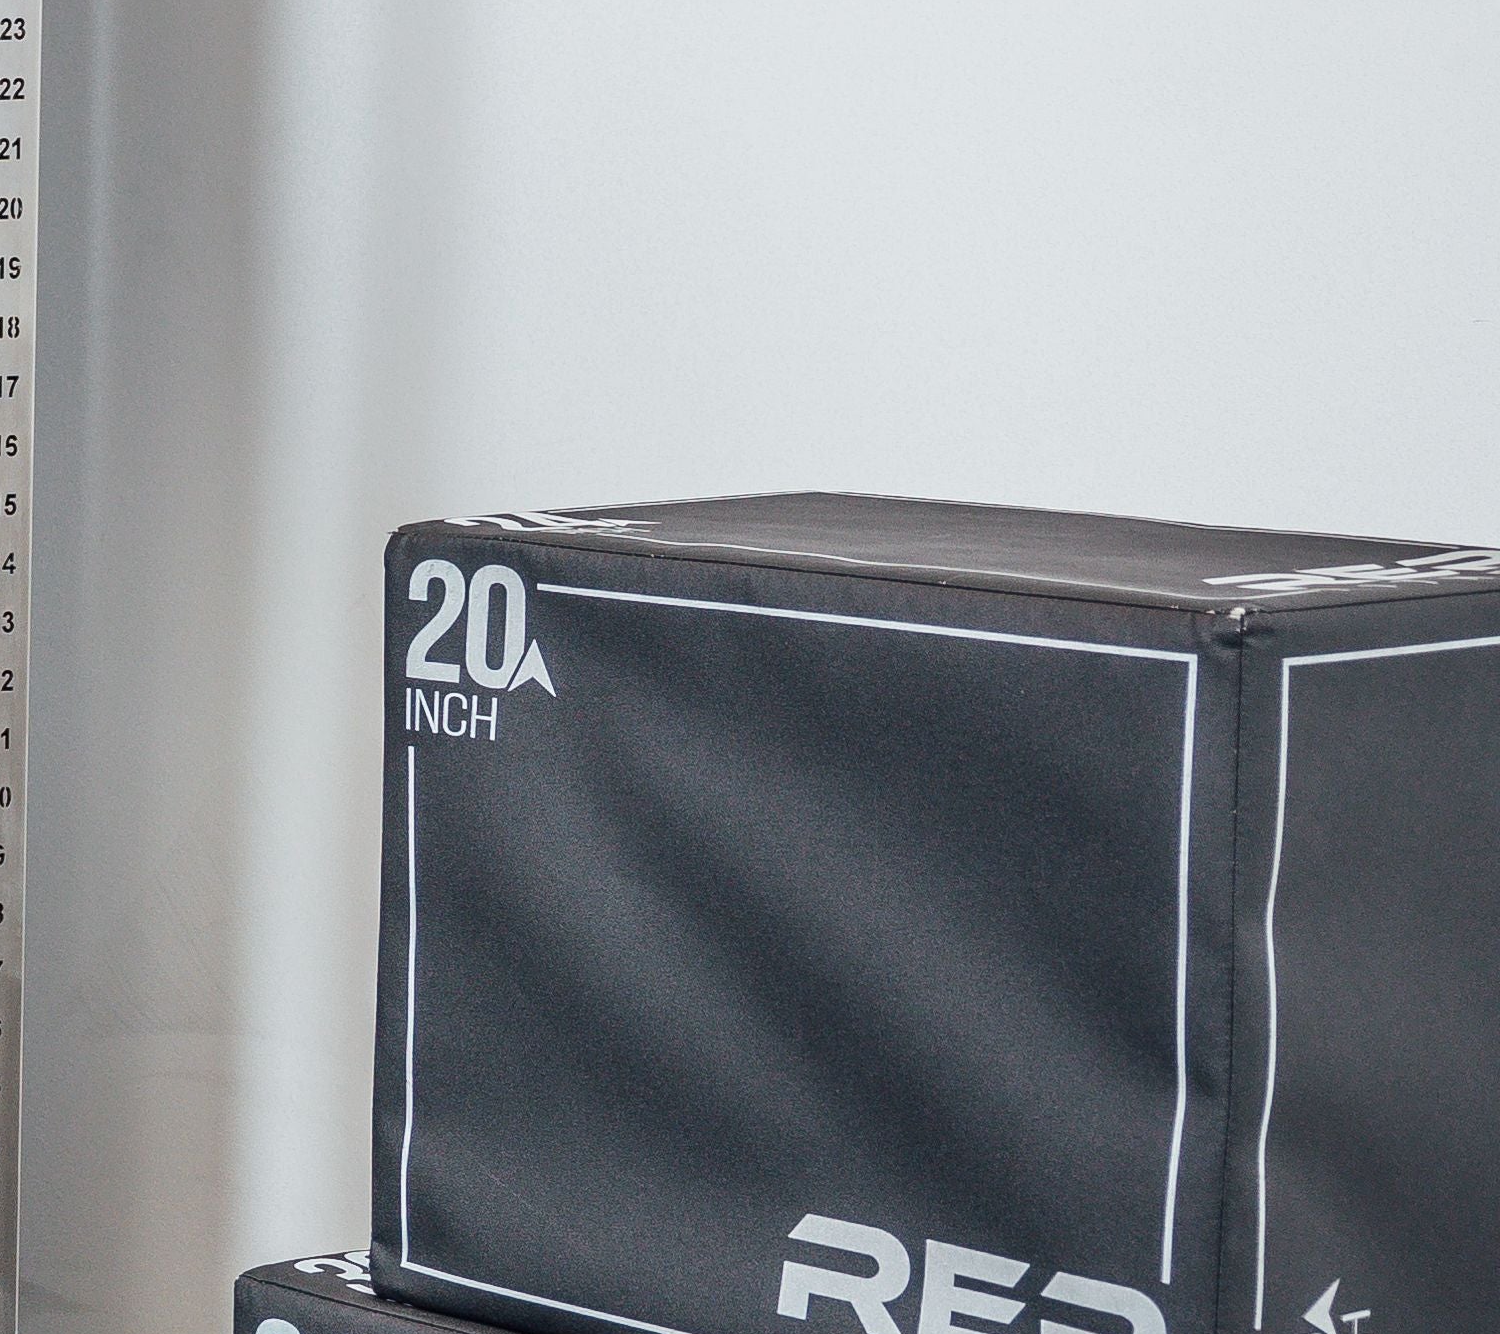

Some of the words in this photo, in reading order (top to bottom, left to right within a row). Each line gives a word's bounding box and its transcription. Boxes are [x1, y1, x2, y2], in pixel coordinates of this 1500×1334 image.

[0, 17, 26, 41] 23
[405, 558, 527, 690] 20
[405, 687, 498, 742] INCH
